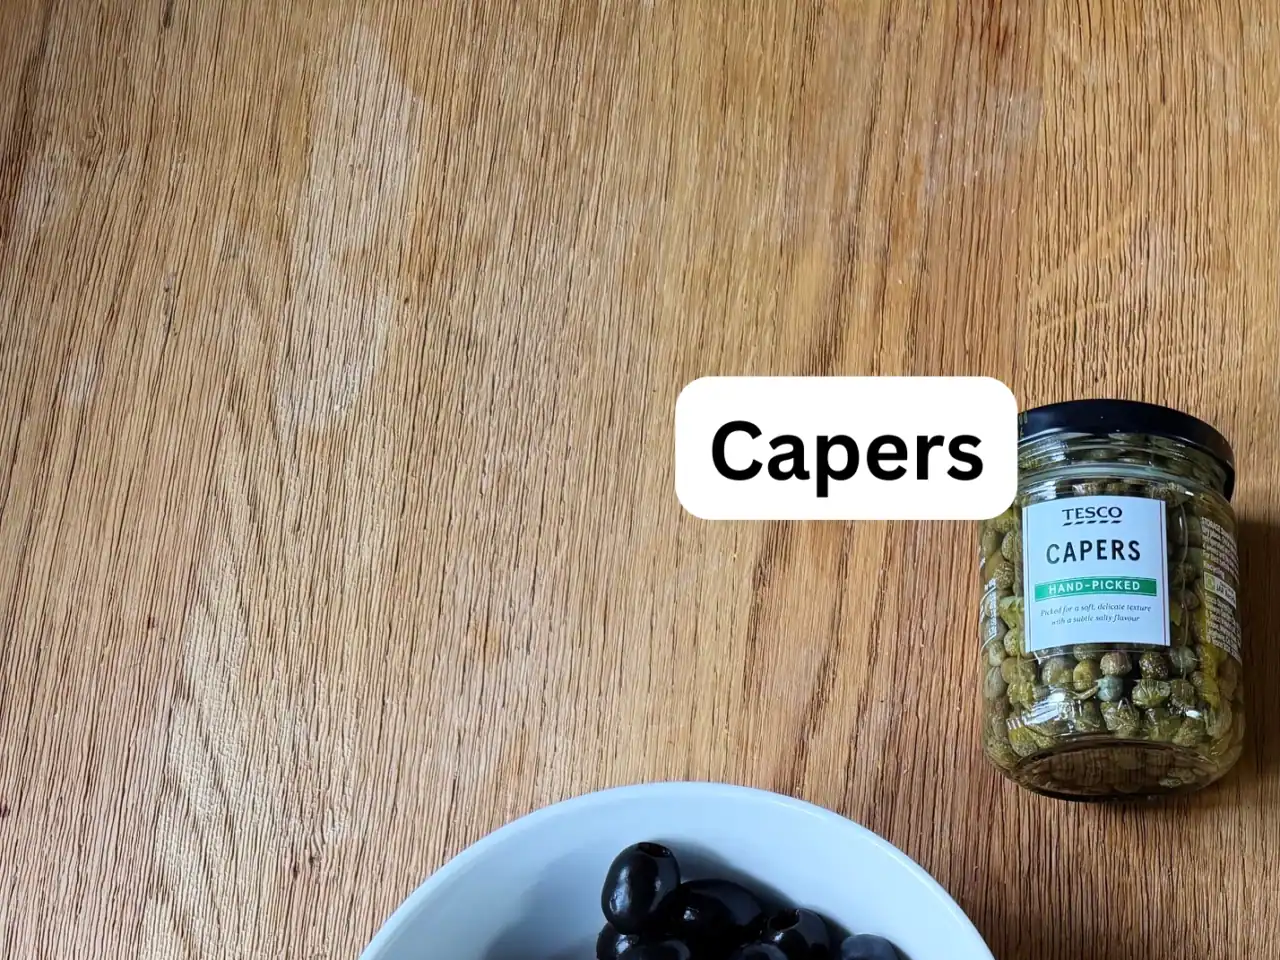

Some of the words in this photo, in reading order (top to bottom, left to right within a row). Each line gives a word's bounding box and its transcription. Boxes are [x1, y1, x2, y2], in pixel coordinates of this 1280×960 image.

[1062, 506, 1122, 520] TESCO
[1046, 539, 1141, 565] CAPERS
[1048, 579, 1140, 595] HAND-PICKED
[1040, 606, 1061, 617] Picked
[1060, 606, 1072, 617] for
[1081, 603, 1095, 613] soft,
[1097, 602, 1125, 611] delicate
[1126, 604, 1151, 612] texture
[1051, 618, 1066, 626] with
[1073, 615, 1094, 624] subtle
[1095, 614, 1112, 624] salty
[1111, 614, 1140, 625] flavour
